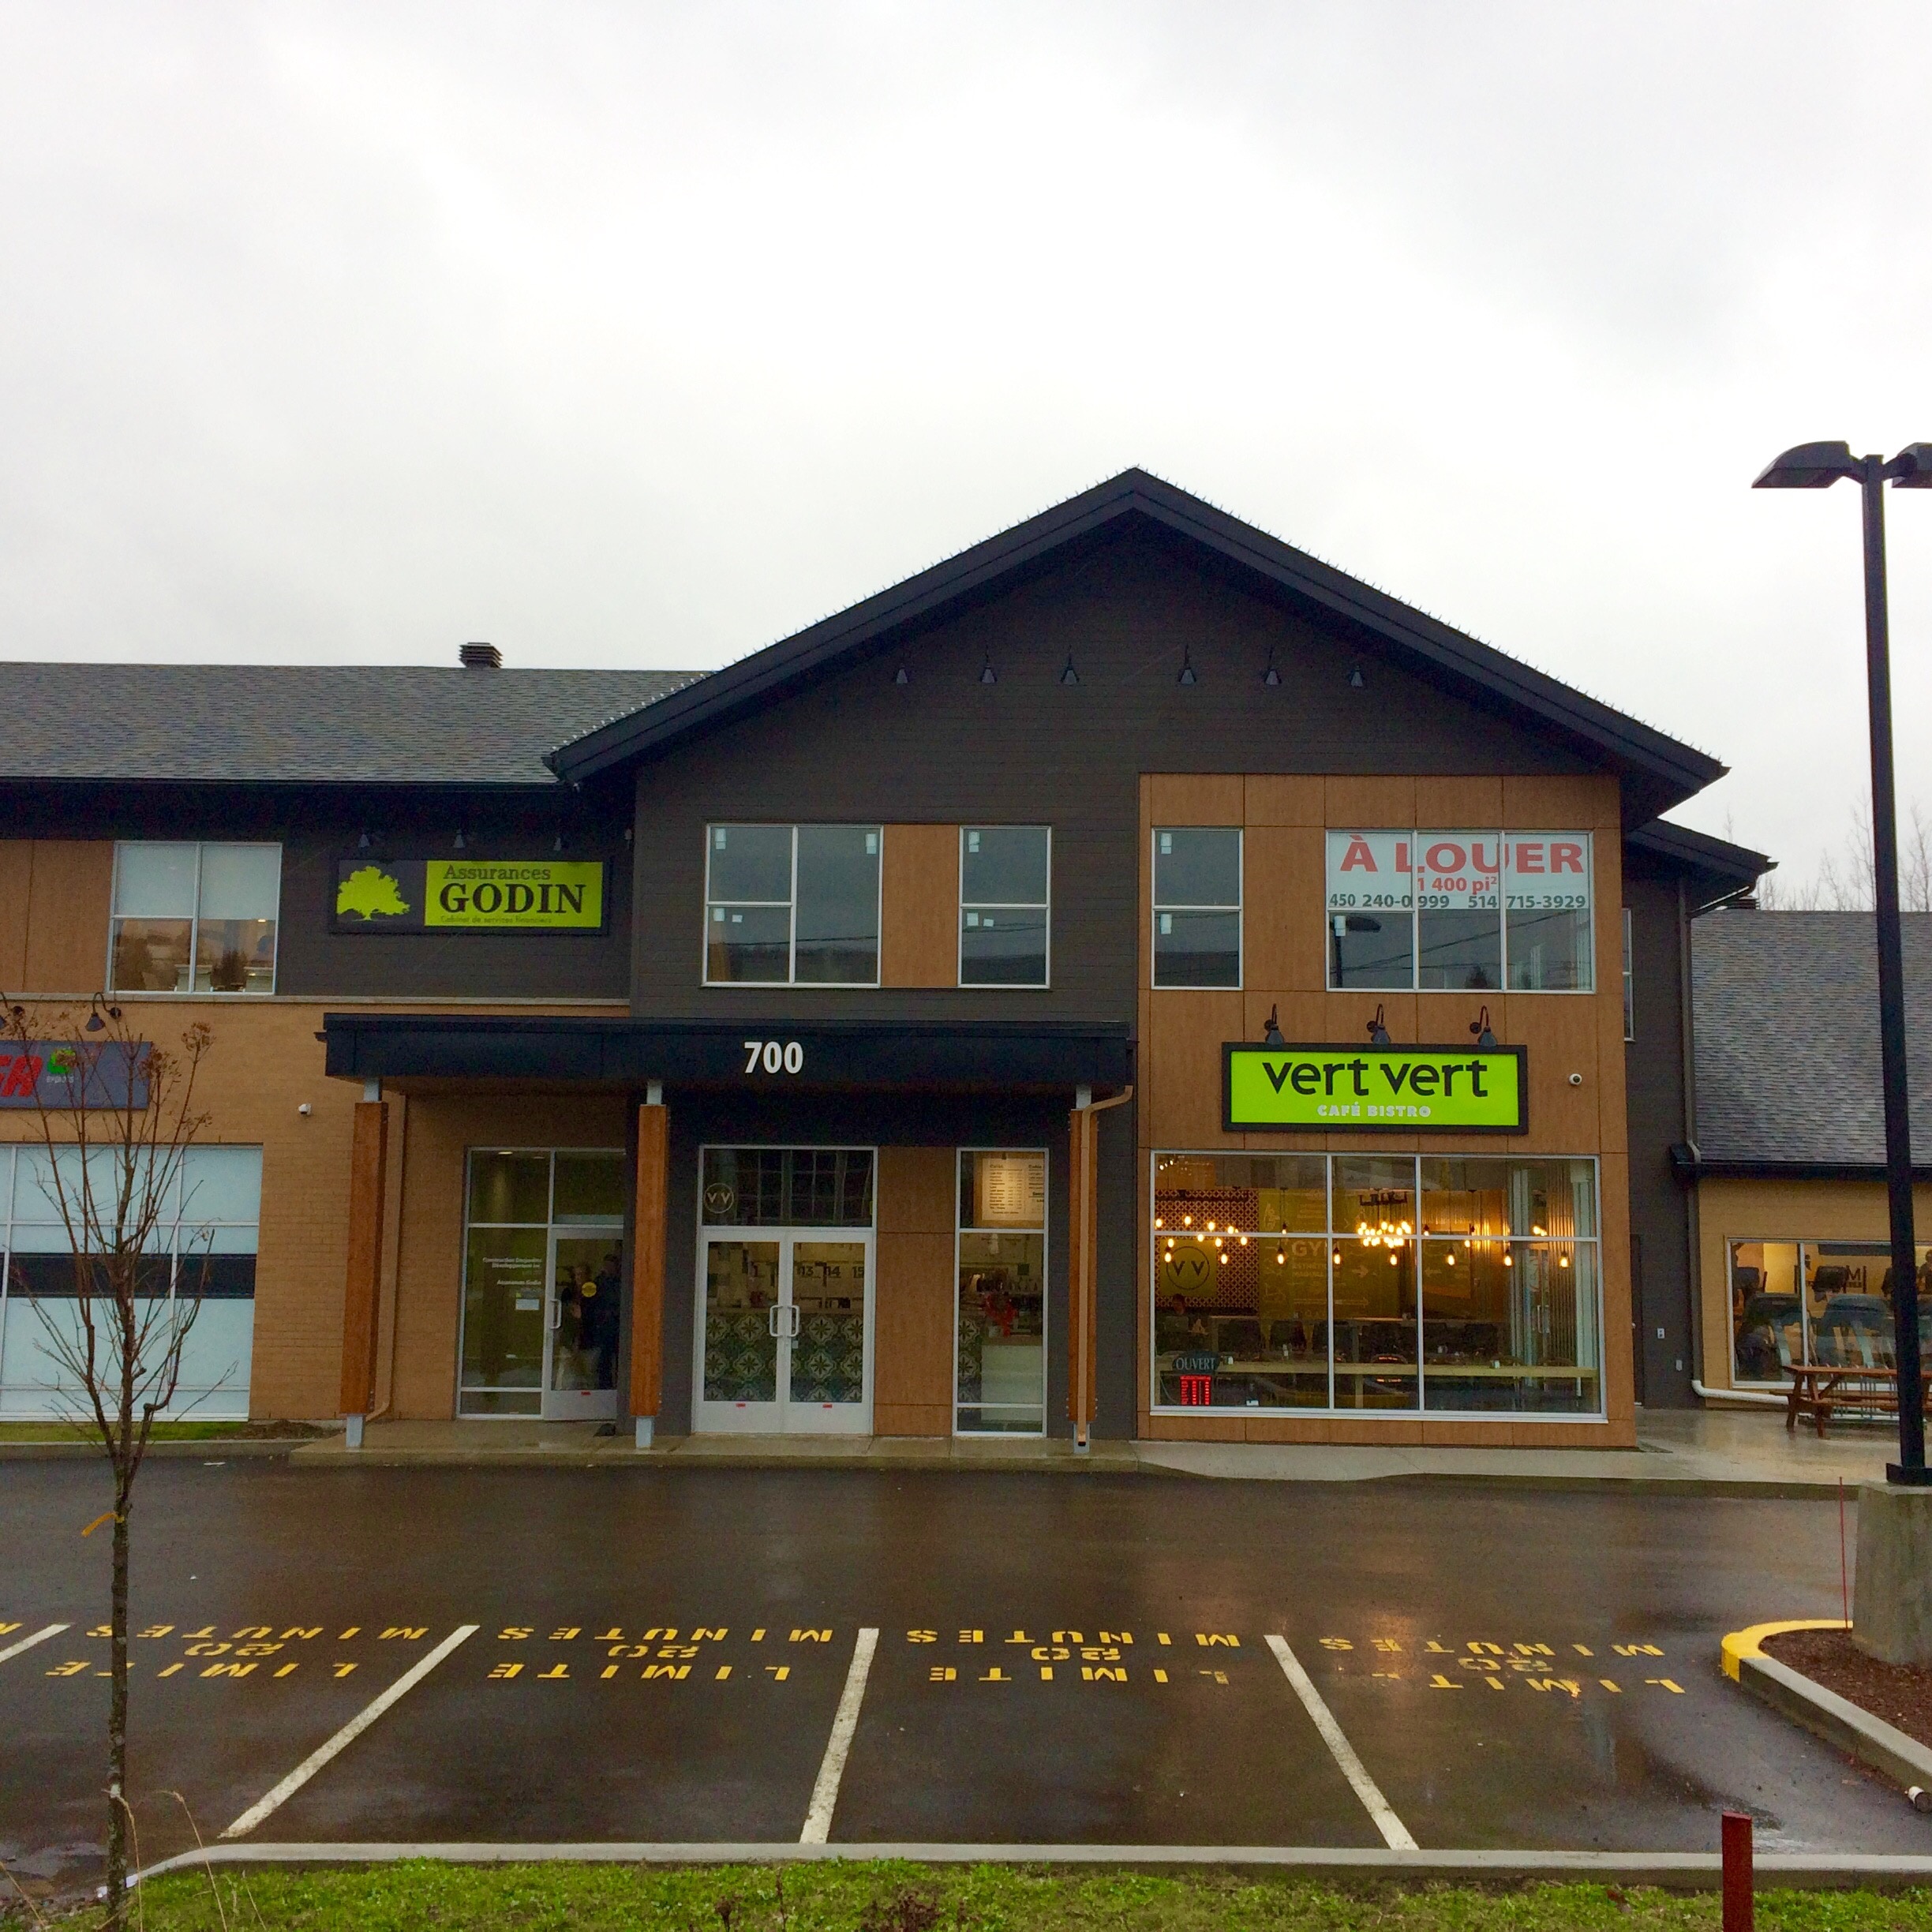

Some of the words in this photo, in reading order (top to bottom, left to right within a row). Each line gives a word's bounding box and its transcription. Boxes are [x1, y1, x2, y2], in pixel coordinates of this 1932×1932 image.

[1339, 834, 1379, 873] À
[1395, 842, 1585, 874] LOUER
[443, 864, 552, 880] Assurances
[1431, 877, 1467, 892] 400
[439, 882, 586, 914] GODIN
[1329, 893, 1356, 907] 450
[1361, 893, 1450, 908] 240-0999
[1467, 894, 1497, 908] 514
[1506, 894, 1586, 909] 715-3929
[744, 1041, 803, 1073] 700
[1262, 1058, 1369, 1096] vert
[1379, 1059, 1488, 1097] vert
[1317, 1102, 1361, 1117] CAFÉ
[1367, 1105, 1432, 1118] BISTRO
[1175, 1357, 1215, 1371] OUVERT
[497, 1625, 833, 1642] MINUTES
[906, 1630, 1241, 1647] MINUTES
[184, 1642, 285, 1656] 20
[607, 1644, 700, 1658] 20
[1032, 1647, 1121, 1661] 20
[1318, 1638, 1664, 1657] MINUTES
[487, 1664, 790, 1681] LIMITE
